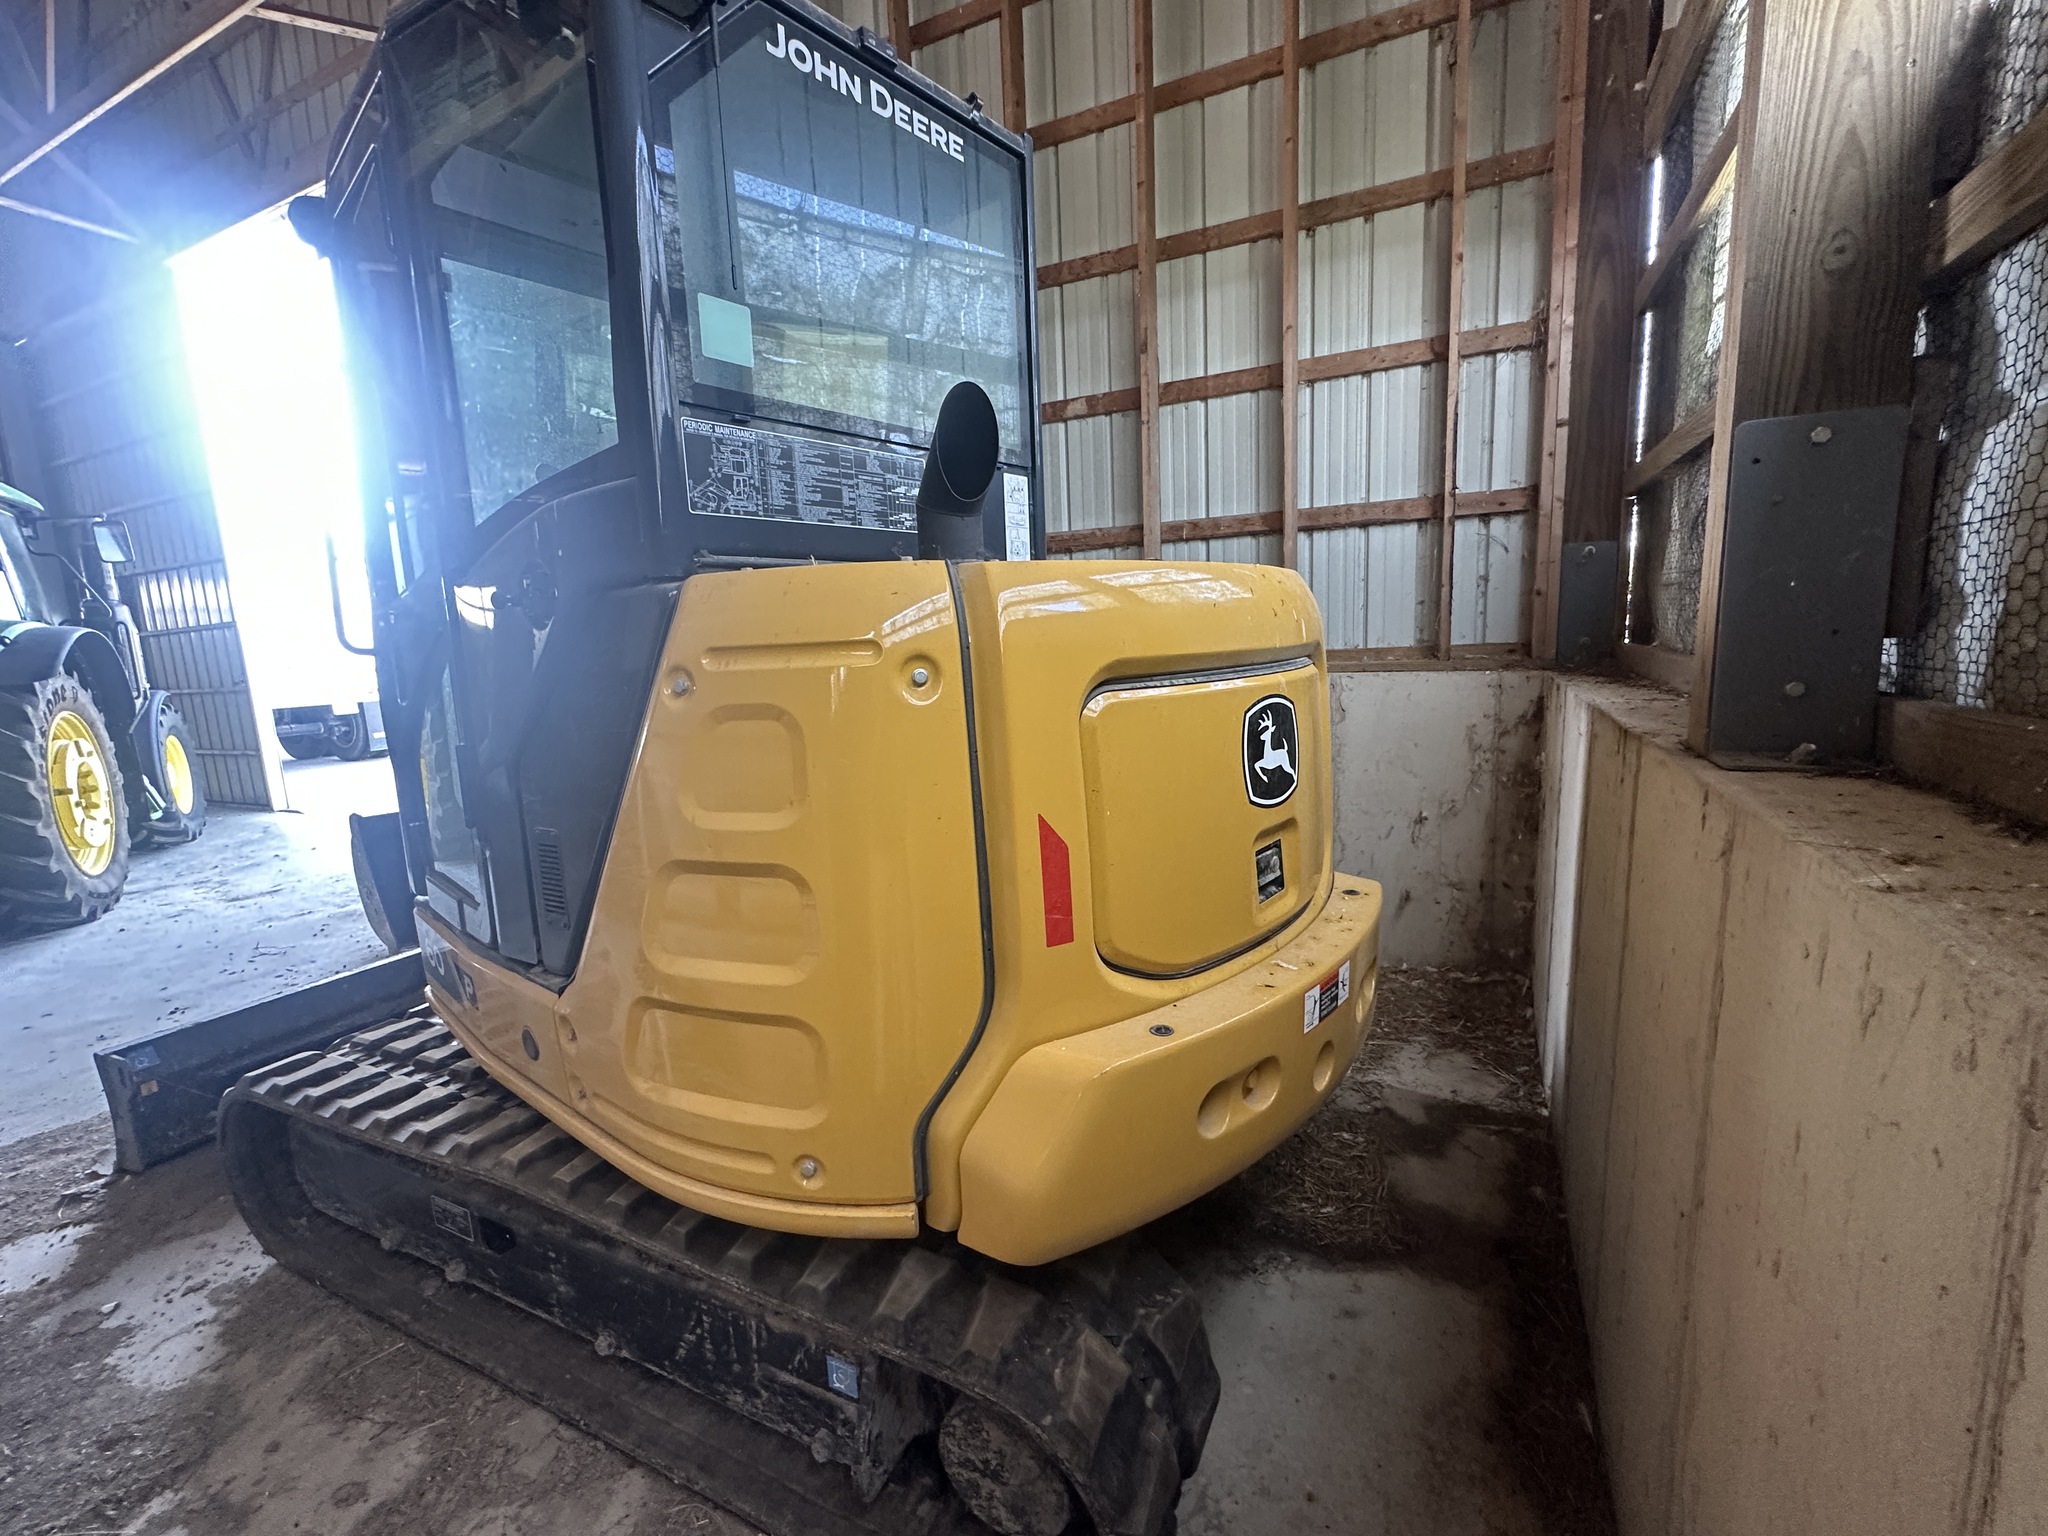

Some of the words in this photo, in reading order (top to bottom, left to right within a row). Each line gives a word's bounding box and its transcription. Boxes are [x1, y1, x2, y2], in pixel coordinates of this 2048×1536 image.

[765, 23, 862, 104] JOHN
[869, 79, 965, 162] DEERE
[683, 420, 714, 433] PERIODIC
[714, 425, 757, 439] MAINTENANCE
